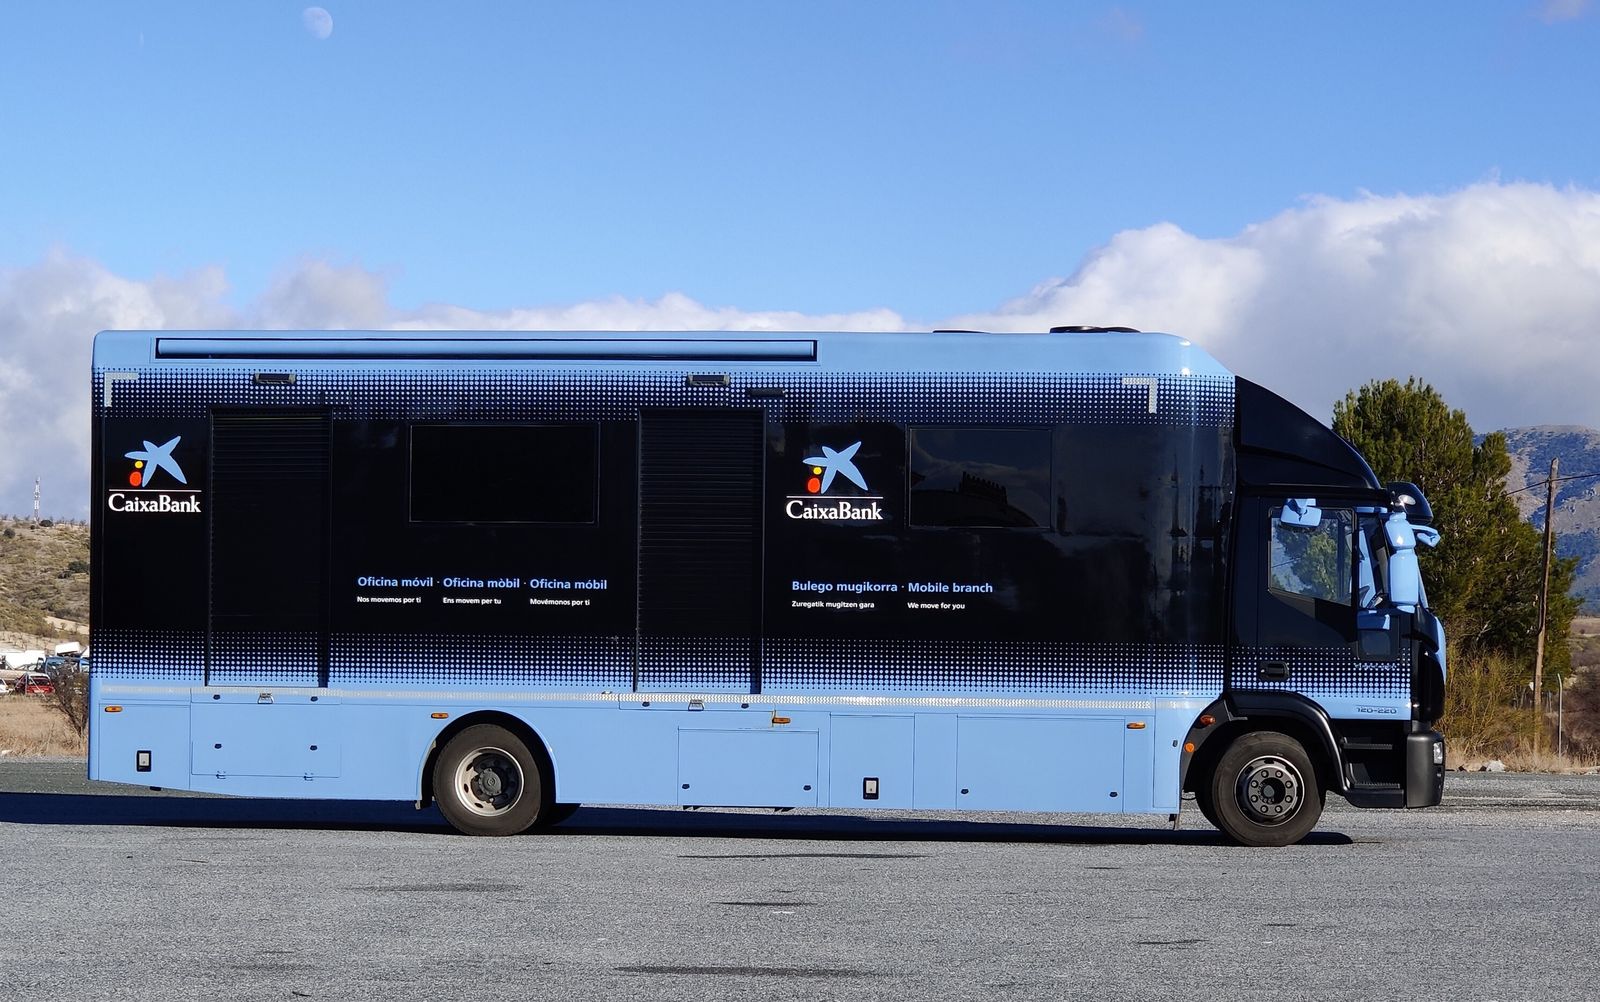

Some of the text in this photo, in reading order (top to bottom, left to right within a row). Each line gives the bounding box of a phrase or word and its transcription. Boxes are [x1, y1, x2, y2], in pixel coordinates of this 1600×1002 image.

[108, 493, 202, 513] CaixaBank
[786, 500, 884, 520] CaixaBank
[357, 576, 607, 590] Oficina móvil Oficina mòbil Oficina móbil
[792, 580, 993, 593] Bulego mugikorra Mobile branch
[402, 597, 415, 605] por
[415, 596, 422, 604] ti
[442, 596, 455, 604] Ens
[480, 598, 493, 606] per
[529, 598, 571, 606] Movémonos
[571, 599, 584, 607] por
[791, 600, 875, 610] Zuregatik mugitzen gara
[907, 601, 920, 609] We
[940, 601, 952, 609] for
[951, 603, 966, 611] you
